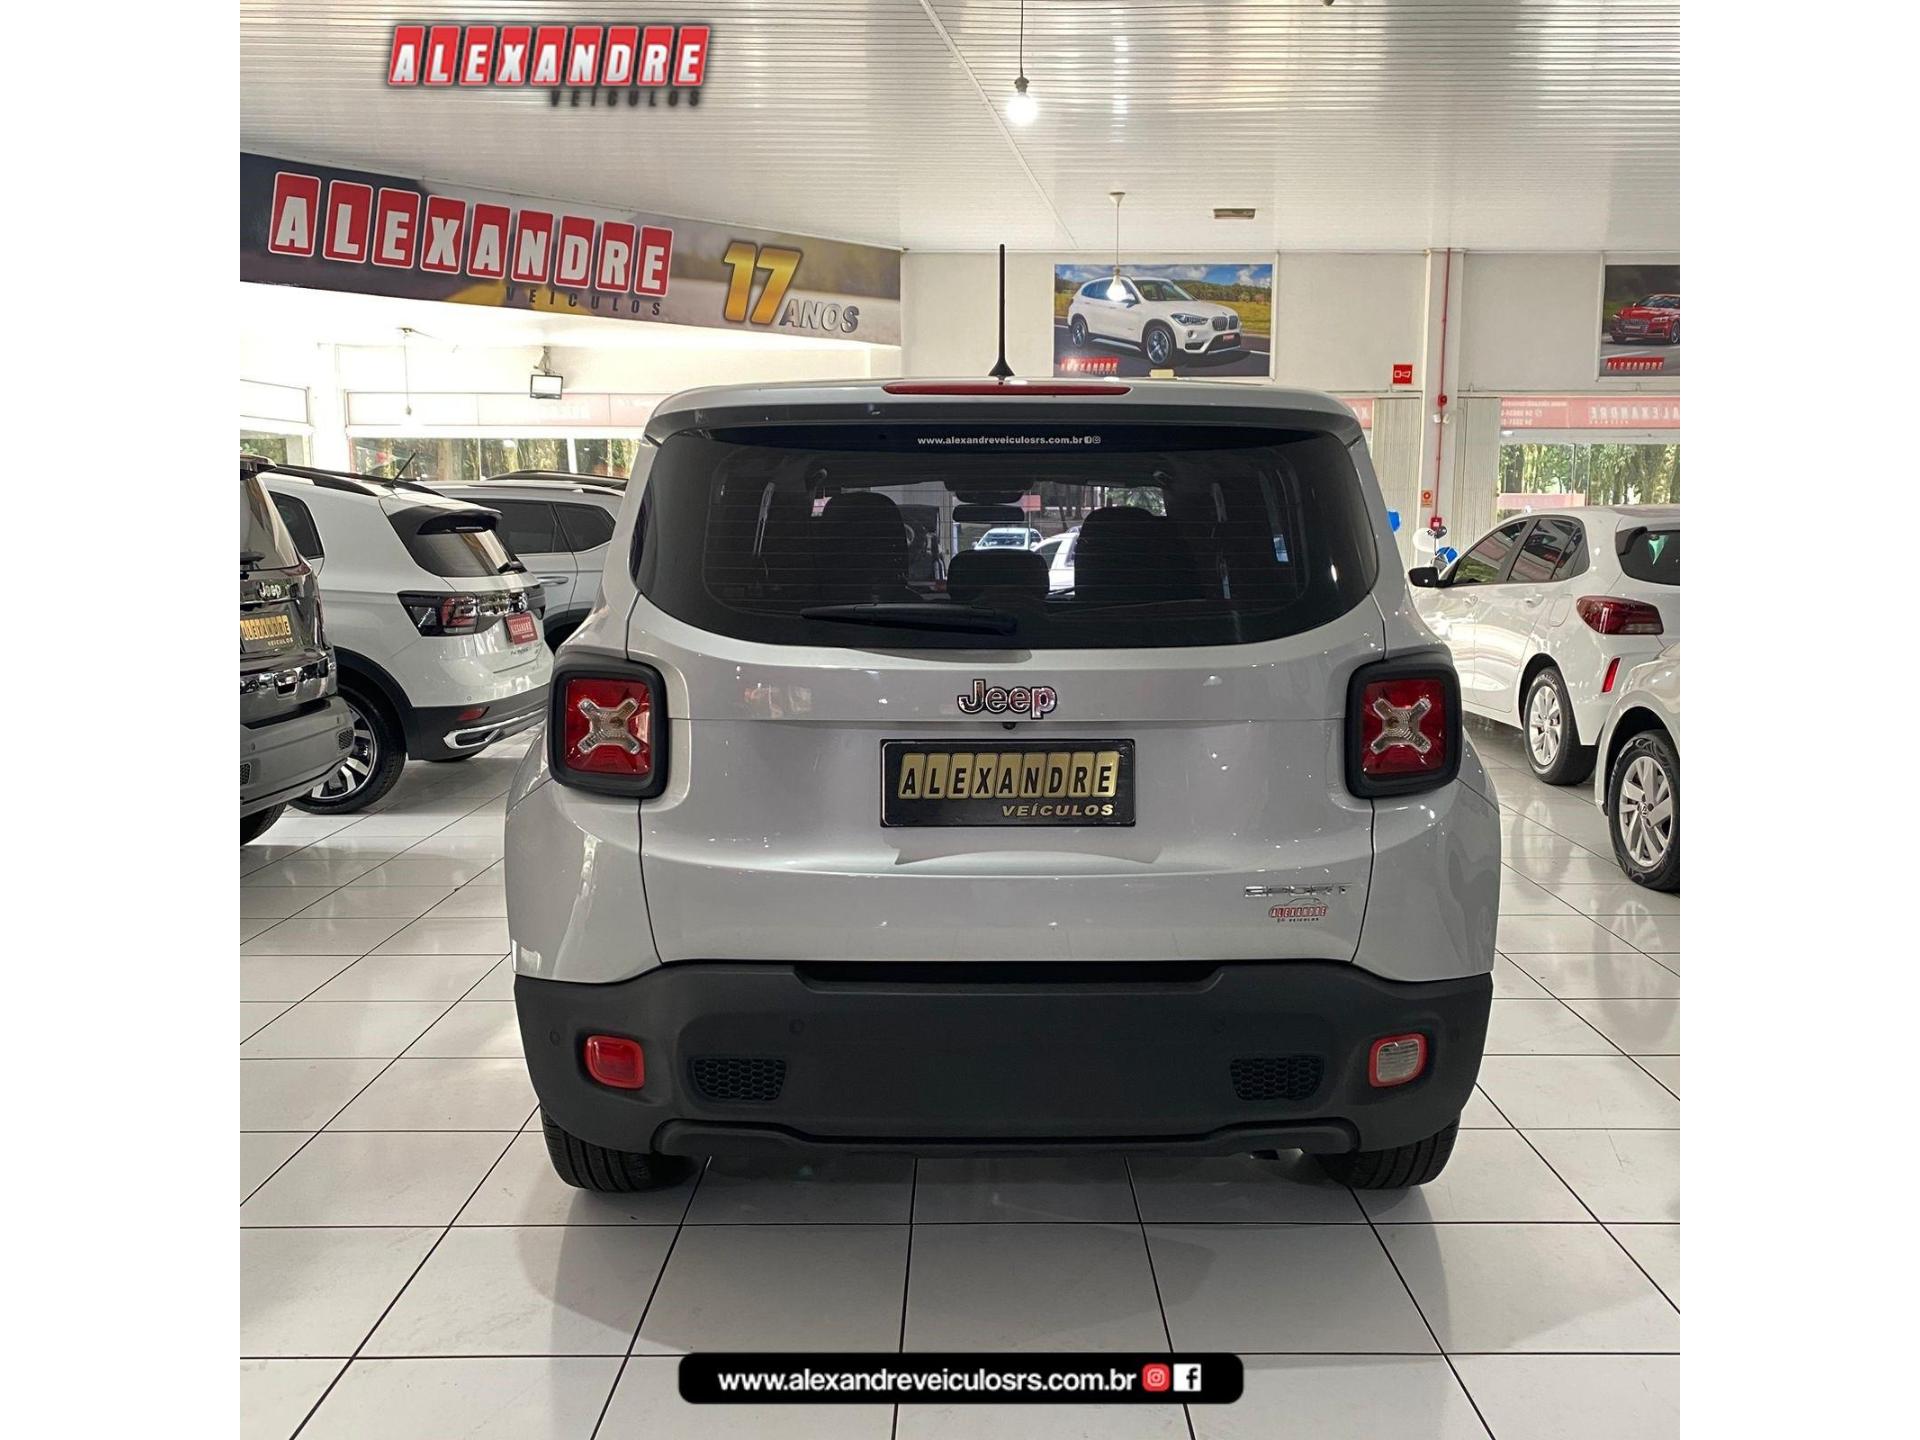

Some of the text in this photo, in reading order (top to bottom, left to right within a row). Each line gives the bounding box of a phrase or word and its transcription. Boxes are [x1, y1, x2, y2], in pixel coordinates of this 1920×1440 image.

[274, 195, 666, 291] ALEXANDRE
[722, 240, 860, 333] 17 ANOS
[917, 435, 1083, 445] www.alexandreveiculosrs.com.br
[257, 582, 281, 599] Jeep
[957, 679, 1057, 720] Jeep
[901, 765, 1114, 795] ALEXANDRE
[1002, 802, 1115, 818] VEÍCULOS
